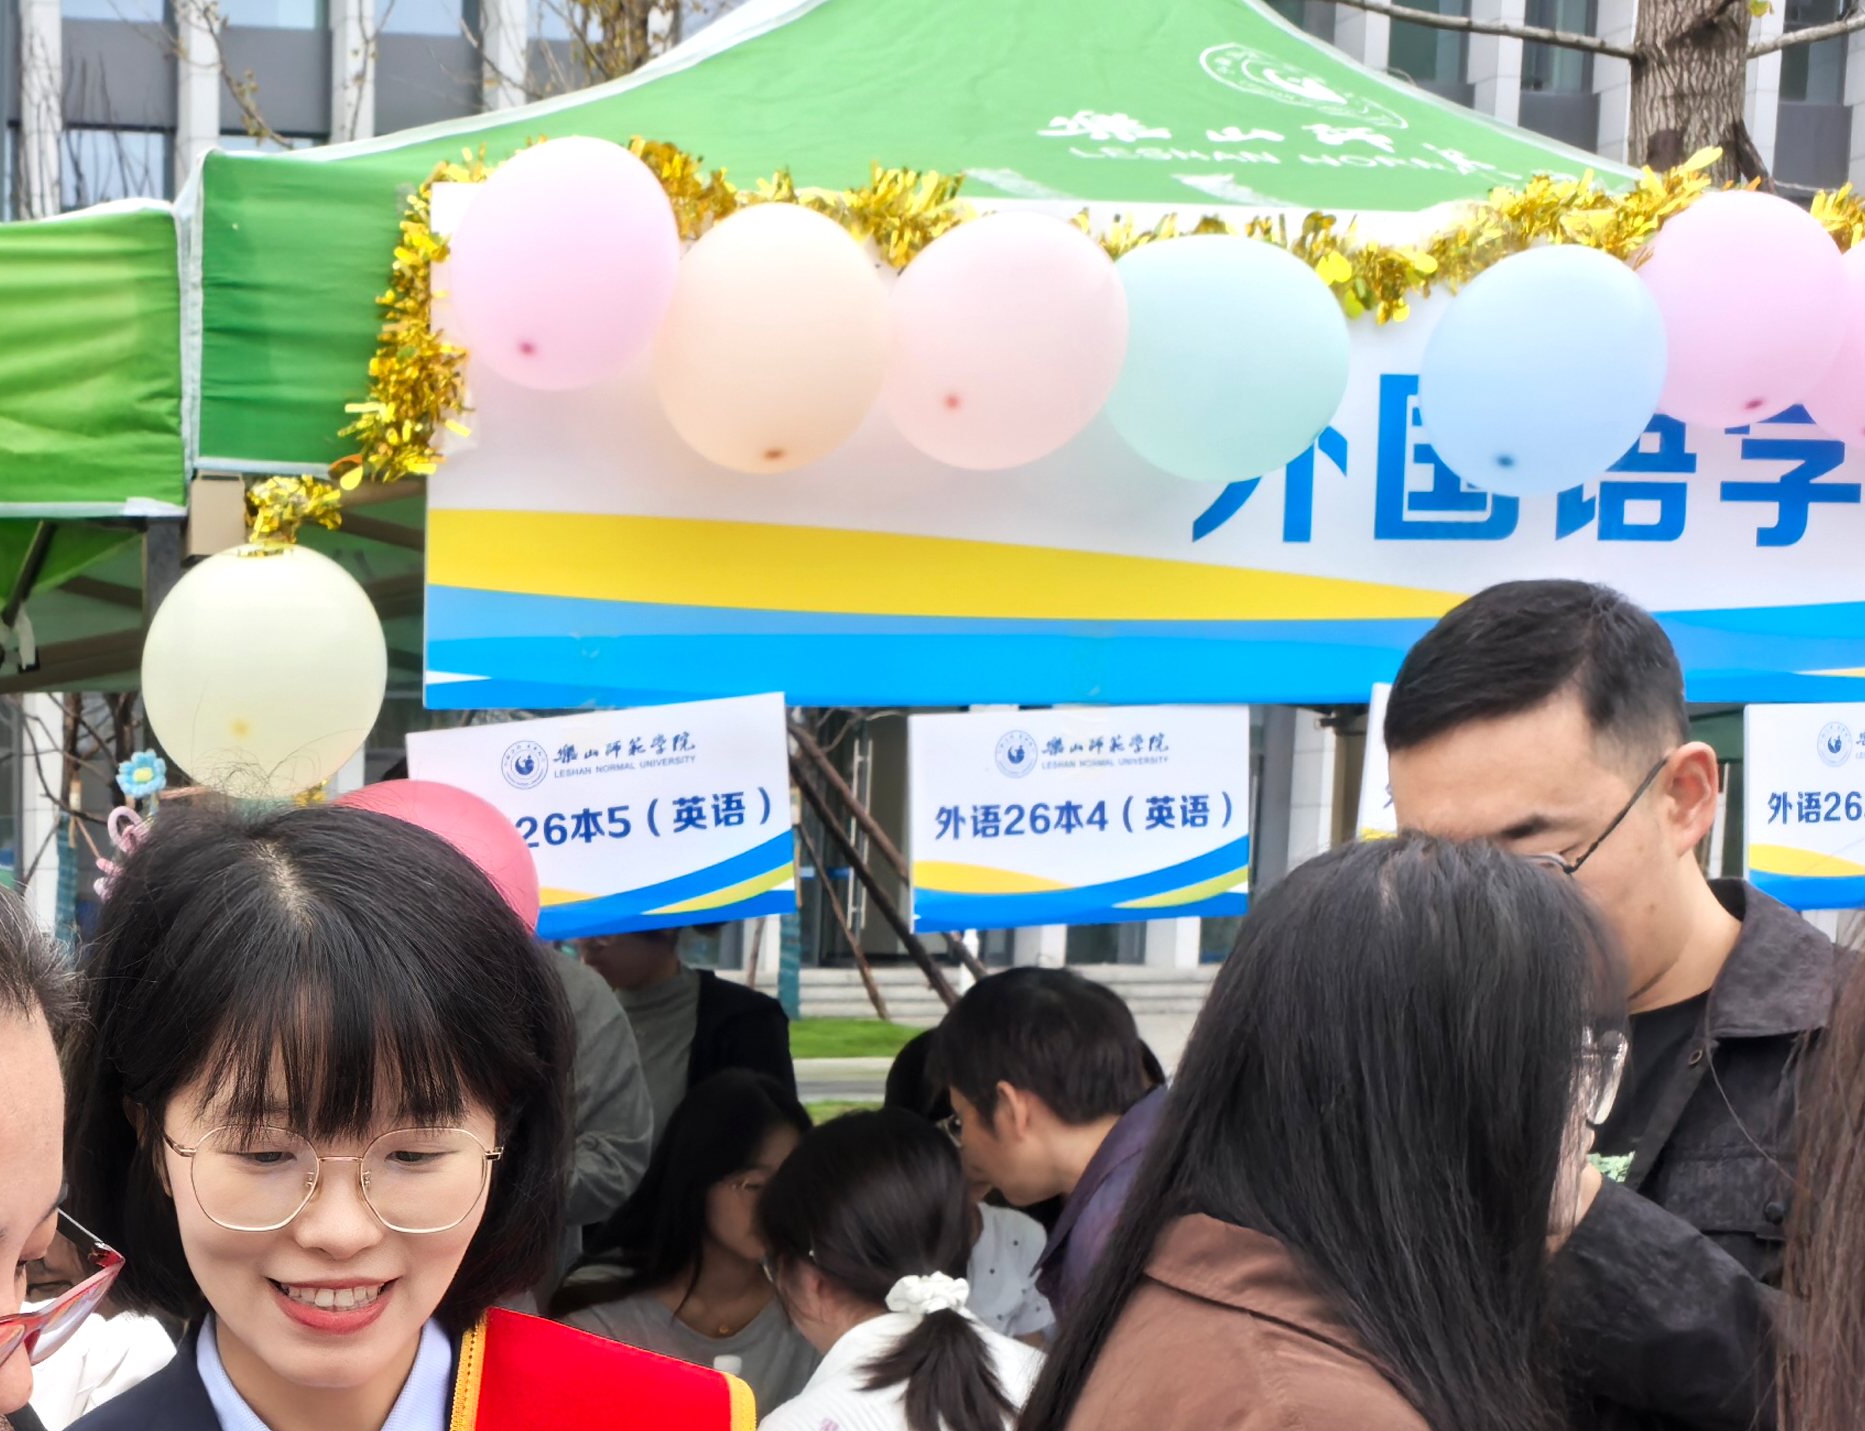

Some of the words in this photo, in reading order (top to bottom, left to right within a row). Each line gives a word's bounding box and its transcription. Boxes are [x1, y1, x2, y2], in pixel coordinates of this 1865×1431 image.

[554, 767, 592, 778] LESHAN
[596, 762, 635, 773] NORMAL
[639, 755, 696, 768] UNIVERSITY
[1042, 760, 1076, 769] LESHAN
[1079, 758, 1115, 768] NORMAL
[1118, 756, 1169, 766] UNIVERSITY
[936, 792, 1232, 840] 外语26本4（英语）
[1767, 791, 1865, 825] 外语26
